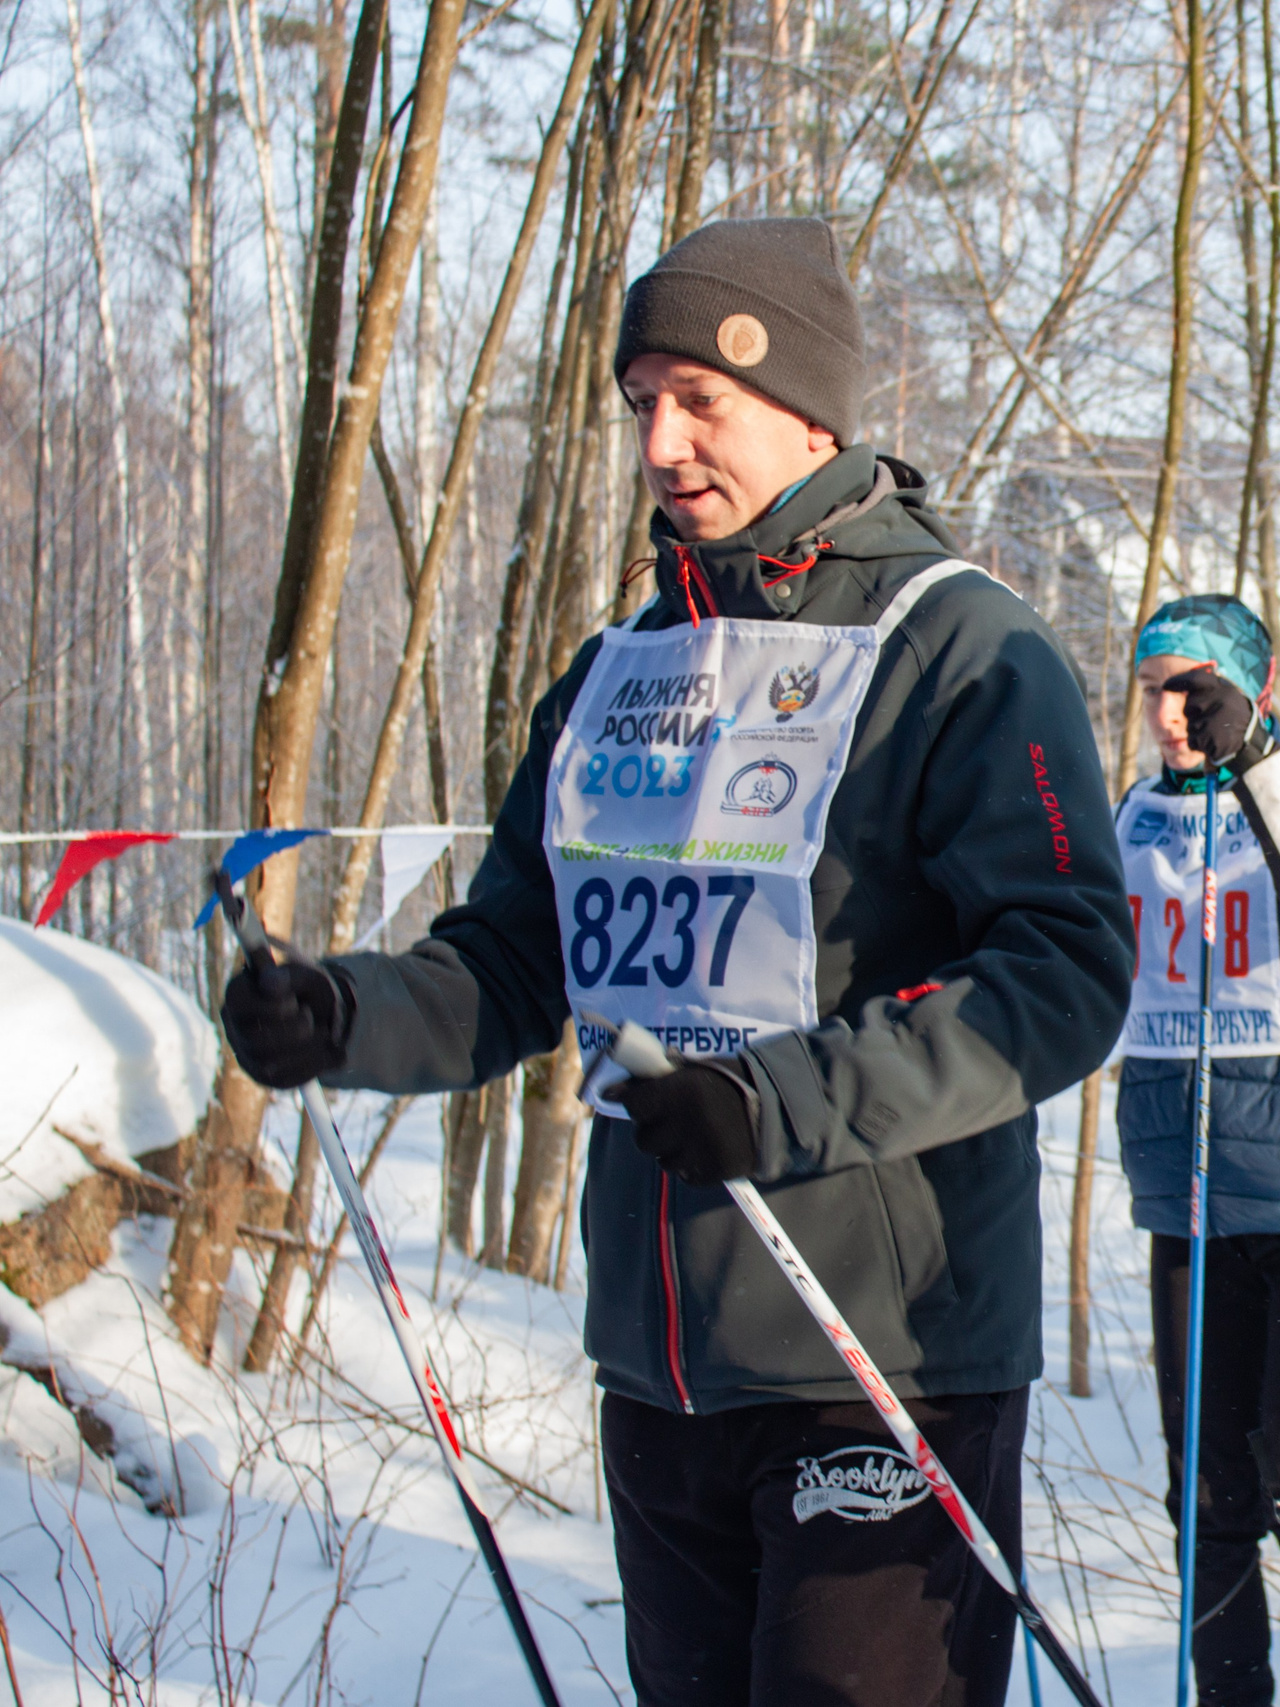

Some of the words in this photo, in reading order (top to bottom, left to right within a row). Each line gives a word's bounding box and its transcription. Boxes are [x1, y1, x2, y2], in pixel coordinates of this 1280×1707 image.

[608, 674, 717, 710] ЛЫЖНЯ
[595, 711, 712, 747] РОССИИ
[582, 752, 694, 798] 2023
[1028, 742, 1073, 873] SALOMON
[700, 841, 789, 862] ЖИЗНИ
[570, 875, 755, 988] 8237
[769, 1232, 816, 1295] STC
[796, 1455, 927, 1504] Brooklyn
